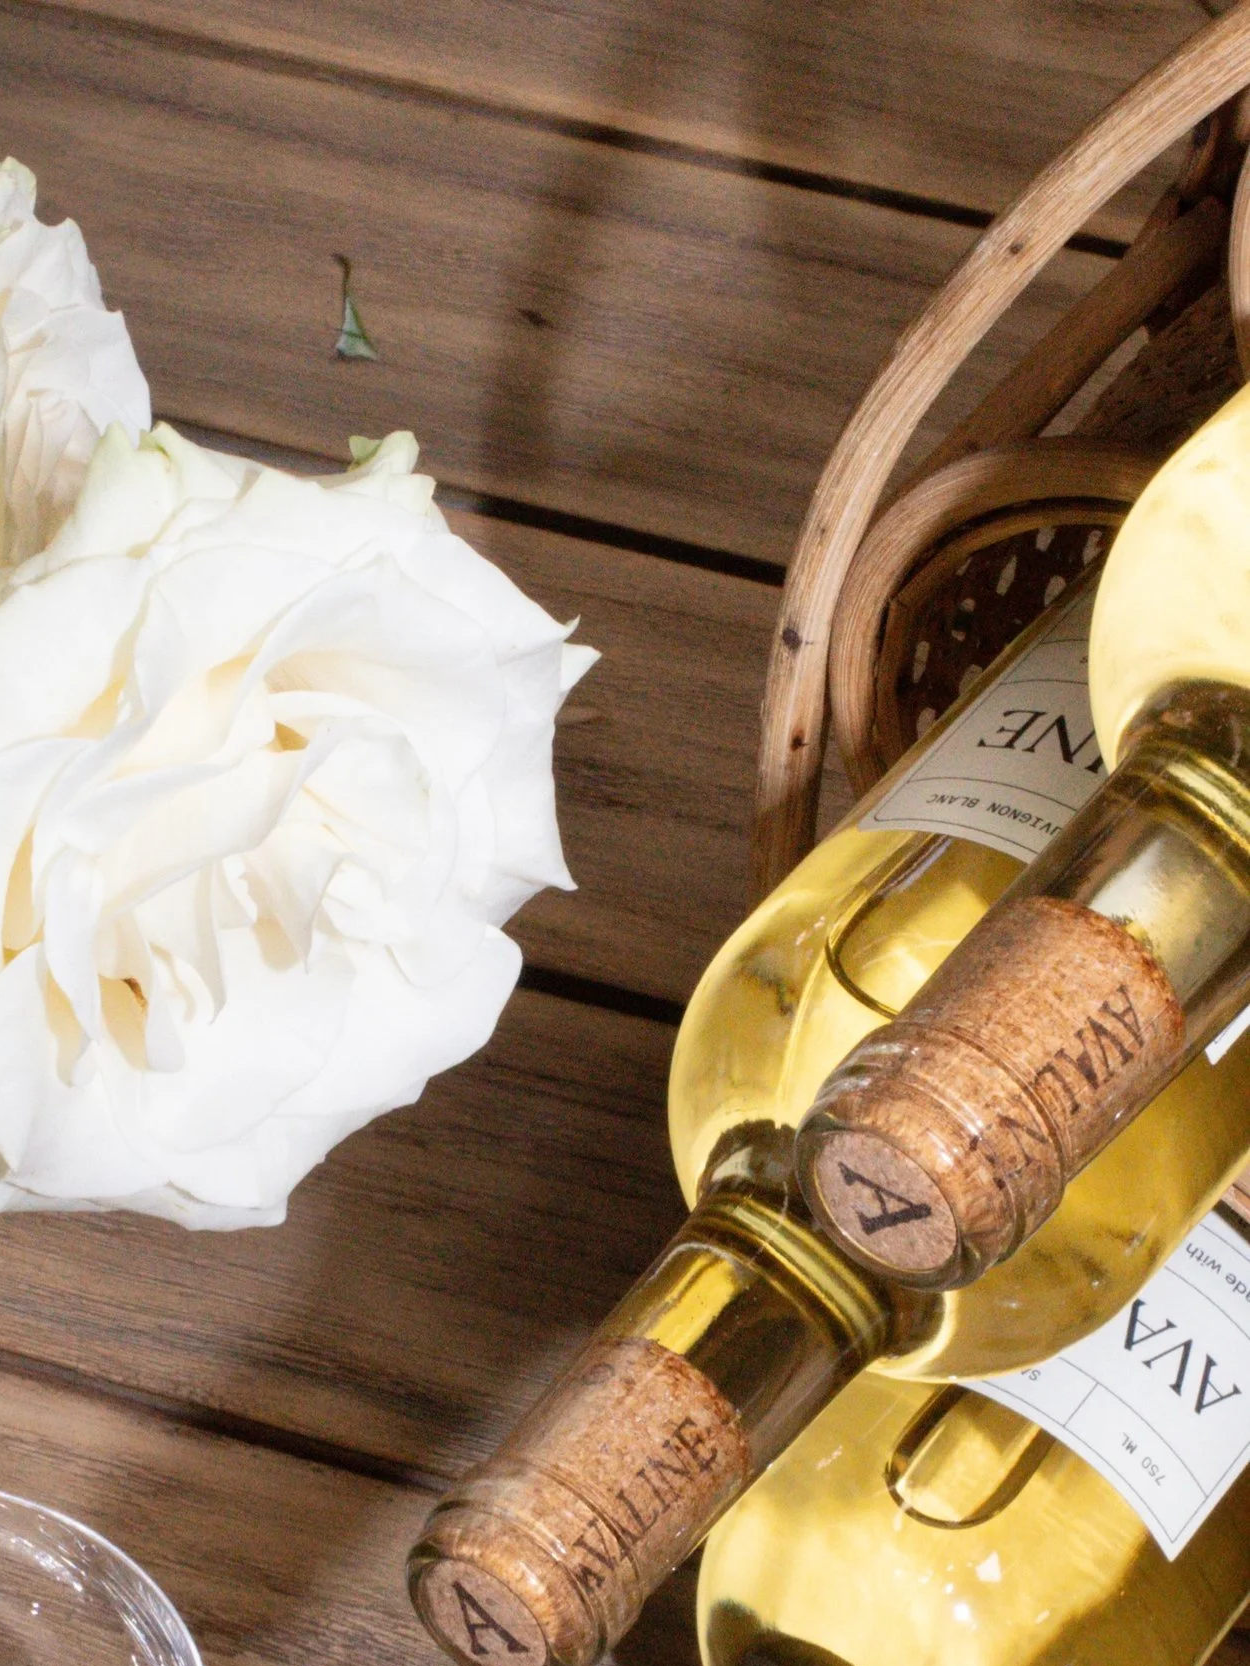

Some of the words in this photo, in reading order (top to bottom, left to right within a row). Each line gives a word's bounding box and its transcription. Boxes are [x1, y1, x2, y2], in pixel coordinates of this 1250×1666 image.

[926, 793, 980, 809] BLANC
[969, 983, 1144, 1190] AVALN
[837, 1161, 933, 1236] A
[1186, 1242, 1222, 1275] with
[1124, 1298, 1243, 1415] AVA
[1120, 1431, 1138, 1455] ML
[1141, 1455, 1167, 1487] 750
[452, 1580, 530, 1657] A
